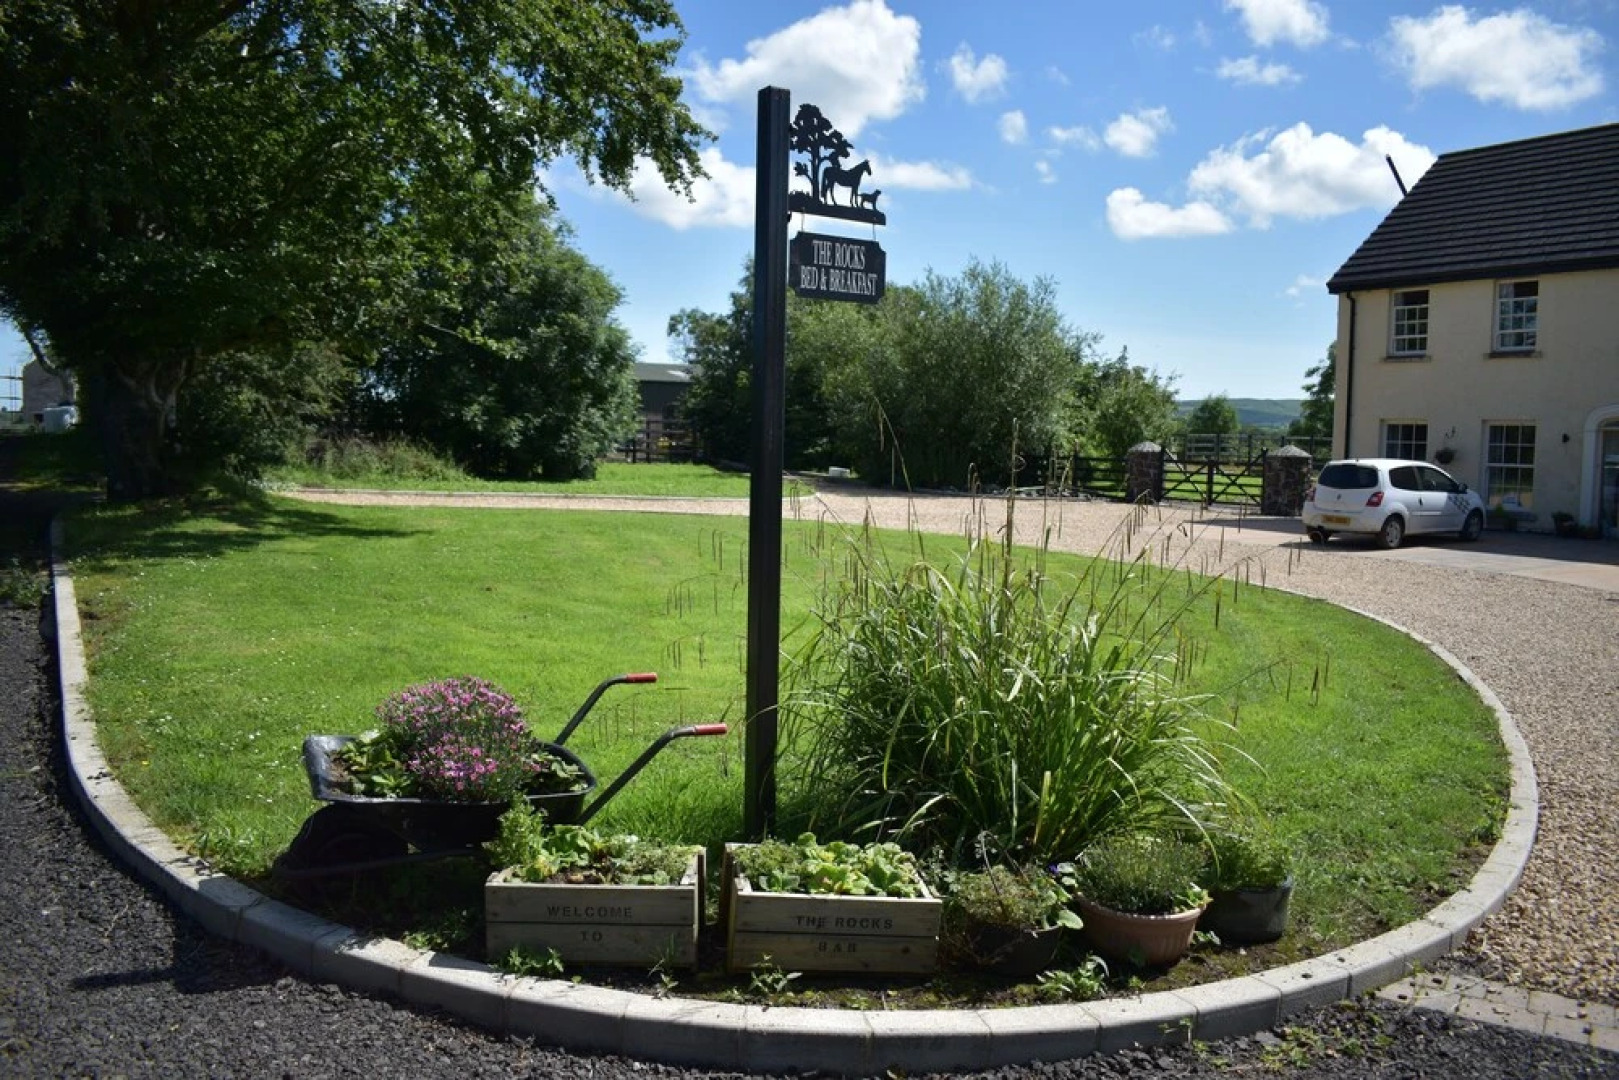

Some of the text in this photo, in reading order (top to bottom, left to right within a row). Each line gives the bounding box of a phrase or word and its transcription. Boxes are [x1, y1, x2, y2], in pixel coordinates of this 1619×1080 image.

[813, 240, 865, 269] THE ROCKS
[800, 265, 878, 295] BED & BREAKFAST
[546, 906, 633, 918] WELCOME
[796, 915, 893, 930] THE ROCKS
[580, 930, 603, 942] TO
